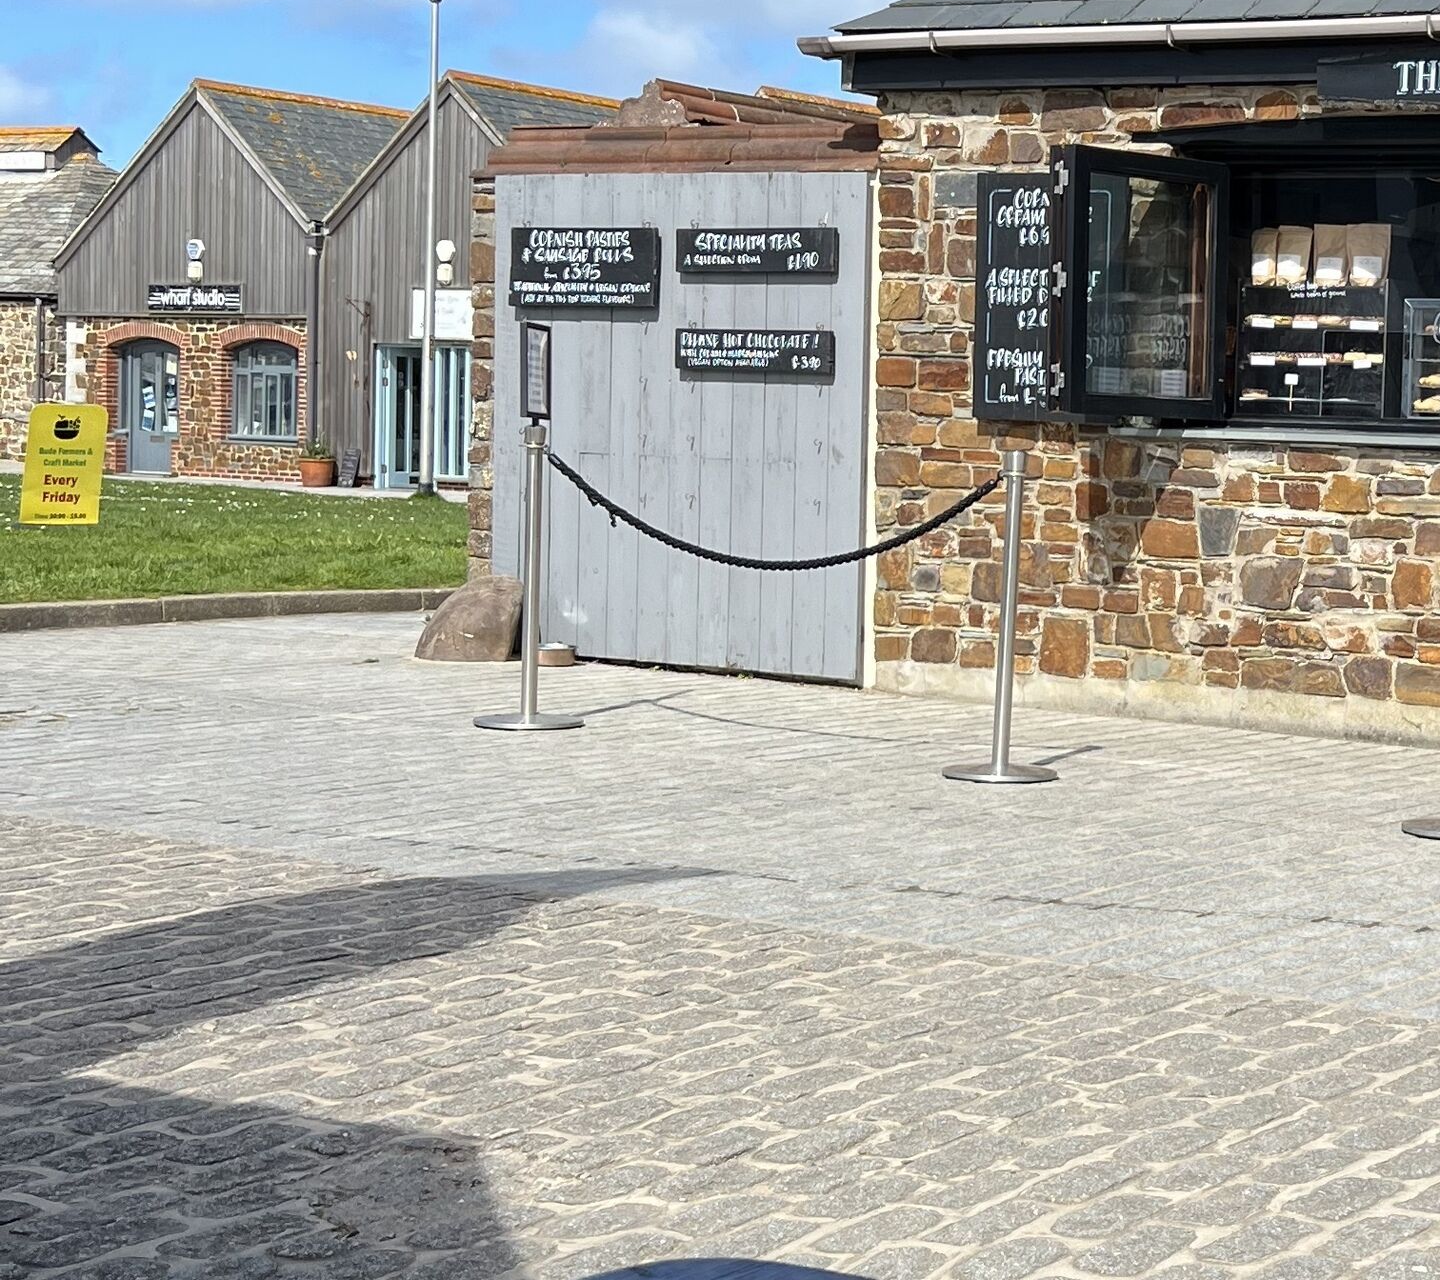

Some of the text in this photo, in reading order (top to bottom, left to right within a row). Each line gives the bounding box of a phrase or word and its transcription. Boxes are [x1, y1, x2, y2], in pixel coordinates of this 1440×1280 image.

[997, 205, 1046, 227] CREAM
[529, 229, 630, 248] CORNISH PASTIES
[695, 232, 802, 252] SPECIALITY TEAS
[534, 248, 589, 262] SAUSAGE
[593, 247, 634, 263] ROLLS
[985, 268, 997, 288] A
[999, 267, 1049, 287] SELECT
[160, 288, 226, 306] wharf studio
[988, 287, 1033, 306] FILLED
[680, 332, 720, 349] DELUXE
[723, 333, 745, 348] HOT
[747, 333, 811, 349] CHOCOLATE
[987, 348, 1043, 369] FRESHLY
[44, 474, 78, 488] Every
[42, 491, 80, 505] Friday
